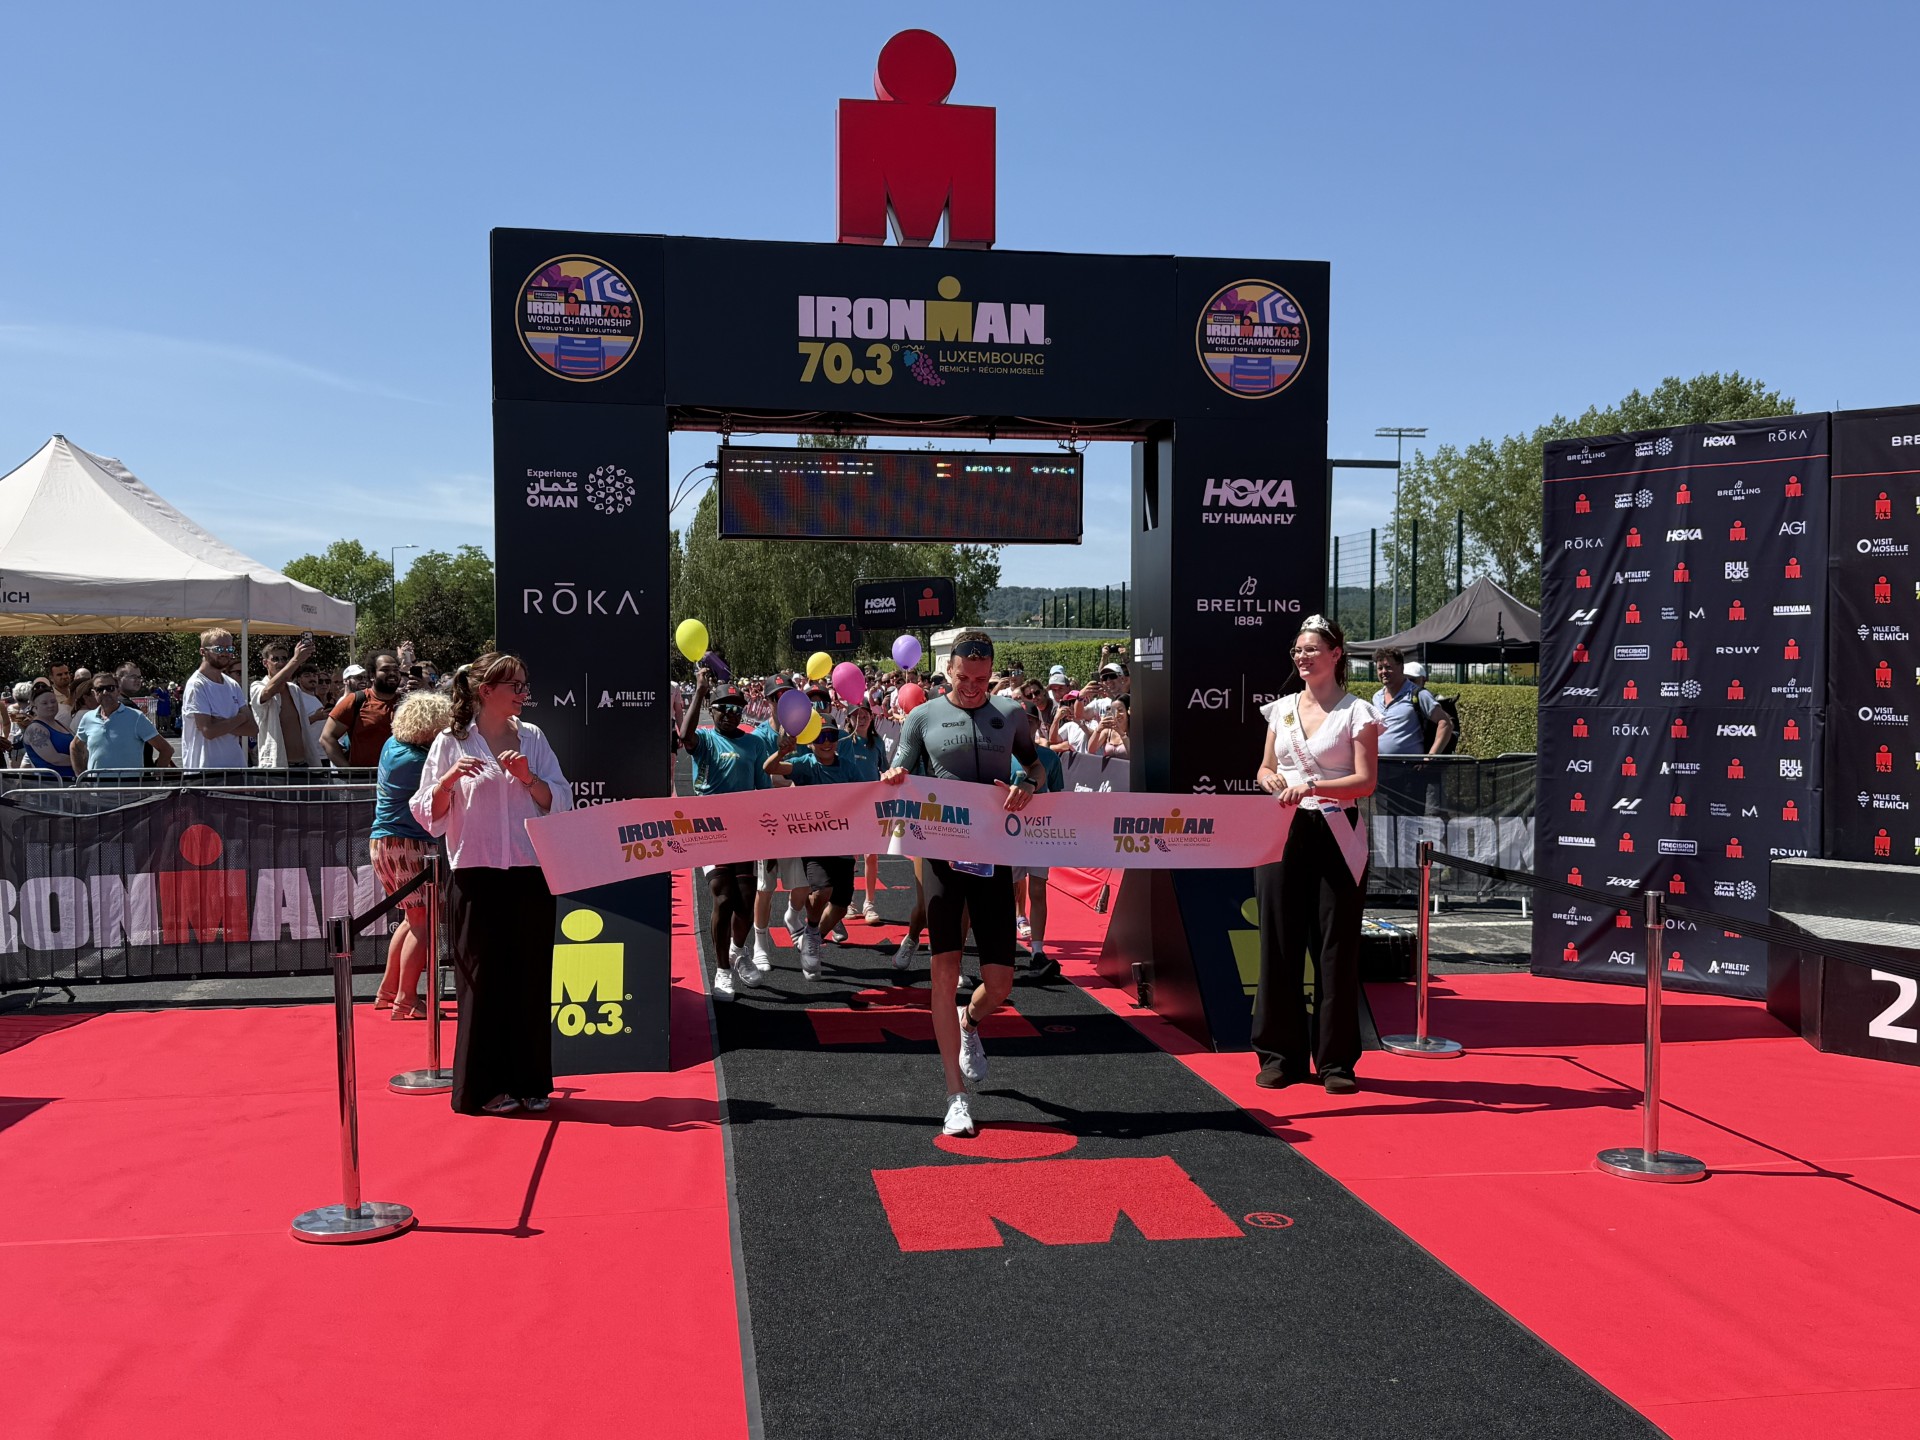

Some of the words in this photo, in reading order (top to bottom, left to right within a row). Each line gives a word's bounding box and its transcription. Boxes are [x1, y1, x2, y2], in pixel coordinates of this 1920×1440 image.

[527, 296, 602, 317] IRONMAN
[602, 305, 632, 318] 70.3
[798, 276, 1045, 345] IRONMAN
[527, 315, 561, 324] WORLD
[563, 316, 632, 327] CHAMPIONSHIP
[1206, 319, 1273, 337] IRONMAN
[1274, 327, 1300, 339] 70.3
[1207, 337, 1236, 345] WORLD
[1237, 338, 1300, 347] CHAMPIONSHIP
[939, 350, 1045, 365] LUXEMBOURG
[798, 342, 893, 386] 70.3
[939, 365, 970, 373] REMICH
[978, 366, 1009, 375] RÉGION
[1009, 367, 1045, 375] MOSELLE
[1703, 435, 1736, 447] HOKA
[1567, 451, 1606, 461] BREITLING
[526, 468, 578, 478] Experience
[1202, 478, 1296, 507] HOKA
[1717, 487, 1761, 496] BREITLING
[526, 495, 579, 508] OMAN
[1202, 513, 1222, 524] FLY
[1224, 513, 1273, 524] HUMAN
[1274, 514, 1295, 525] FLY
[1875, 512, 1891, 520] 70.3
[1778, 521, 1806, 535] AG1
[1666, 528, 1703, 542] HOKA
[1872, 545, 1909, 553] MOSELLE
[1725, 561, 1748, 571] BULL
[1725, 570, 1749, 579] DOG
[865, 597, 896, 609] HOKA
[1196, 599, 1301, 612] BREITLING
[1234, 616, 1263, 626] 1884
[1872, 632, 1909, 641] REMICH
[615, 691, 656, 701] ATHLETIC
[1188, 688, 1230, 709] AG1
[1874, 706, 1893, 714] VISIT
[1874, 714, 1909, 722] MOSELLE
[1716, 725, 1757, 736] HOKA
[1566, 759, 1592, 772] AG1
[1779, 759, 1803, 768] BULL
[1779, 768, 1803, 777] DOG
[570, 781, 606, 796] ISIT
[1224, 780, 1261, 791] VILLE
[1872, 793, 1892, 801] VILLE
[875, 793, 970, 826] IRONMAN
[1872, 800, 1909, 810] REMICH
[782, 811, 813, 822] VILLE
[814, 810, 831, 820] DE
[1024, 816, 1052, 827] VISIT
[1113, 808, 1214, 834] IRONMAN
[618, 811, 725, 844] IRONMAN
[787, 818, 849, 834] REMICH
[1024, 828, 1076, 839] MOSELLE
[1113, 835, 1151, 853] 70.3
[622, 840, 664, 863] 70.3
[1770, 848, 1808, 857] ROUVY
[1874, 849, 1890, 857] 70.3
[1552, 912, 1592, 922] BREITLING
[1608, 951, 1635, 965] AG1
[1721, 962, 1750, 972] ATHLETIC
[1869, 968, 1918, 1043] 2
